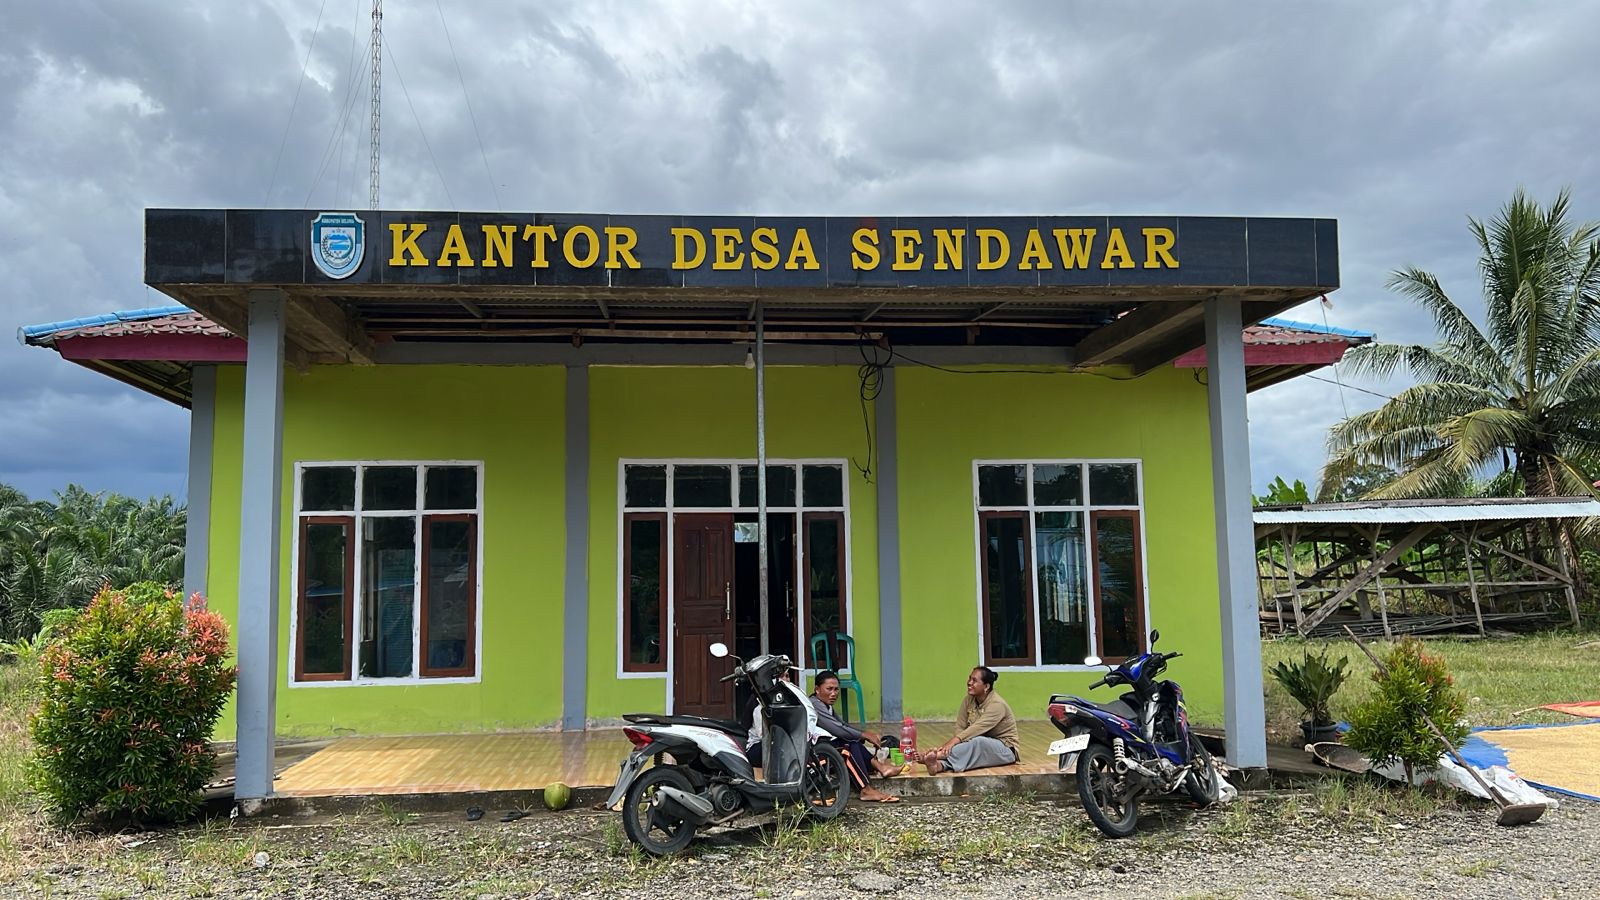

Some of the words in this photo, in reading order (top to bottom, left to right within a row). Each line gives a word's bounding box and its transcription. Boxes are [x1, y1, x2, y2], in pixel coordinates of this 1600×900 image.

[388, 223, 641, 270] KANTOR
[671, 227, 821, 271] DESA
[851, 227, 1180, 271] SENDAWAR
